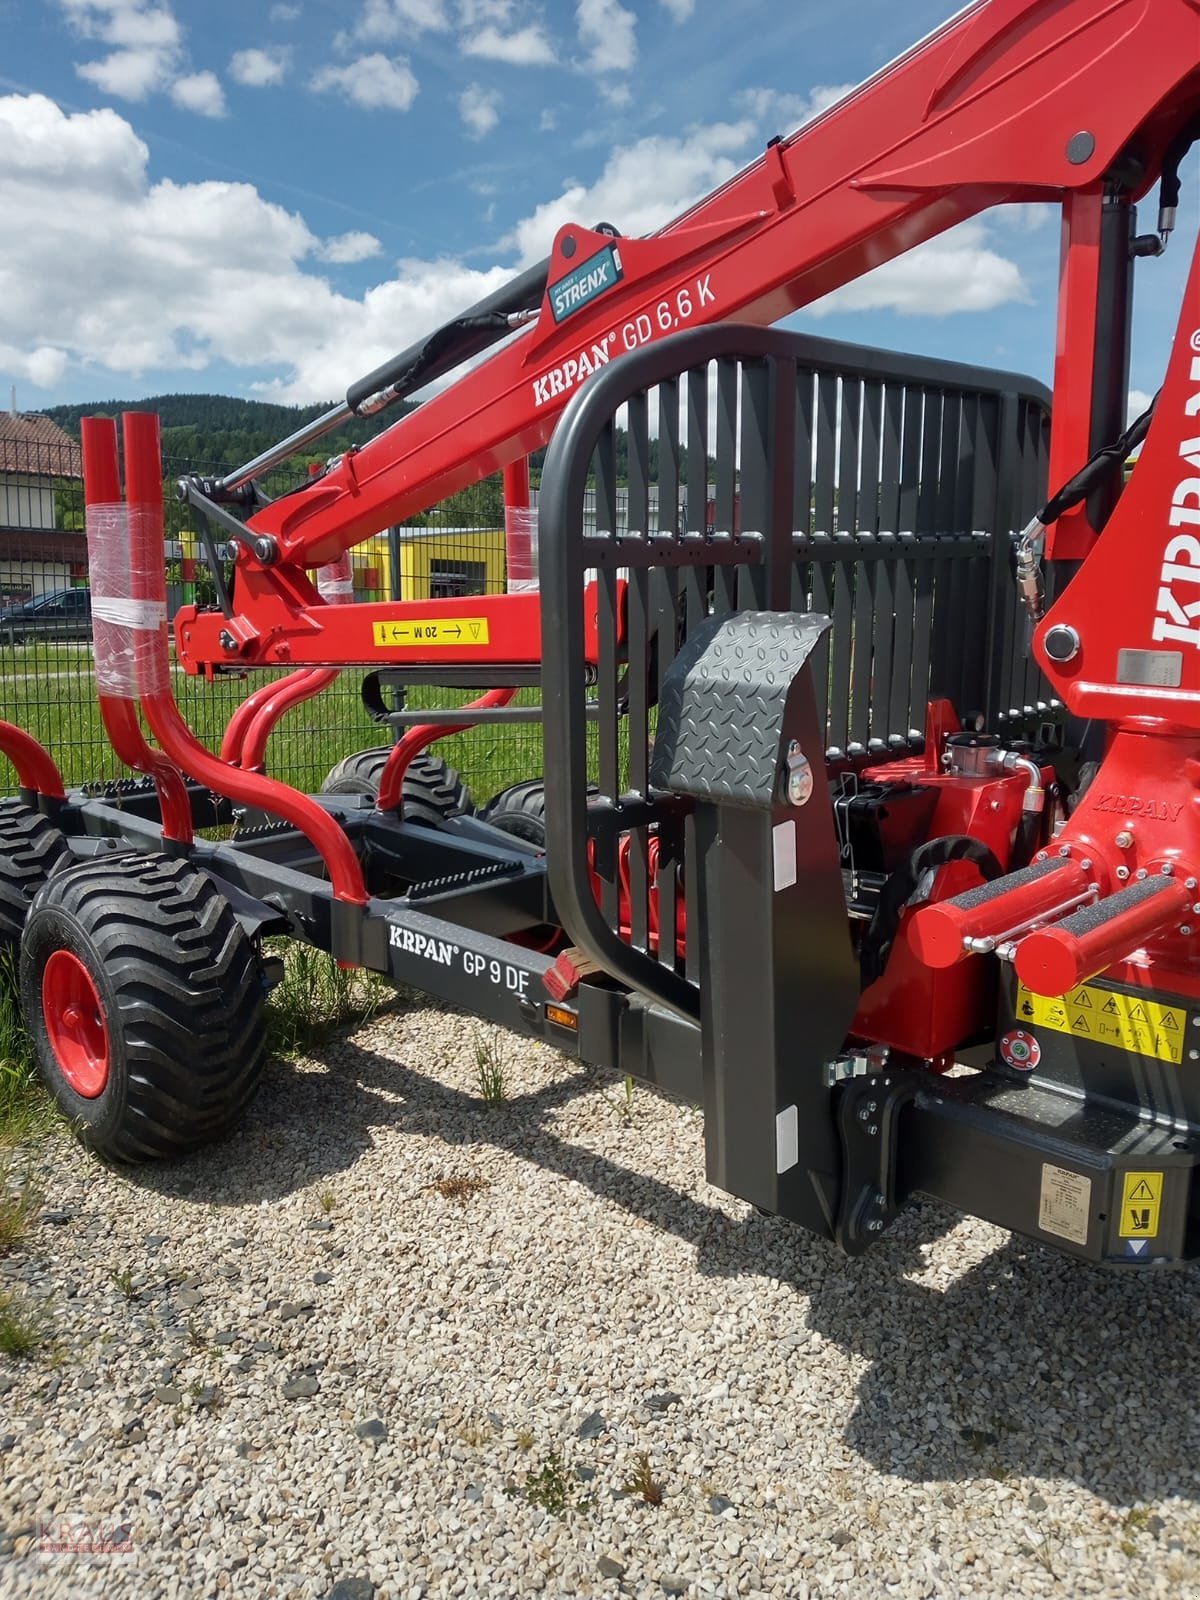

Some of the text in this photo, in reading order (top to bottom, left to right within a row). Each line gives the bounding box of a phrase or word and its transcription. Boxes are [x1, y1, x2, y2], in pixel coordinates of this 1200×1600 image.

[622, 314, 652, 351] GD
[656, 288, 693, 330] 6,6
[697, 273, 716, 307] K
[413, 626, 437, 638] 20 M
[463, 951, 486, 977] GP
[490, 960, 501, 984] 9
[506, 966, 530, 993] DF
